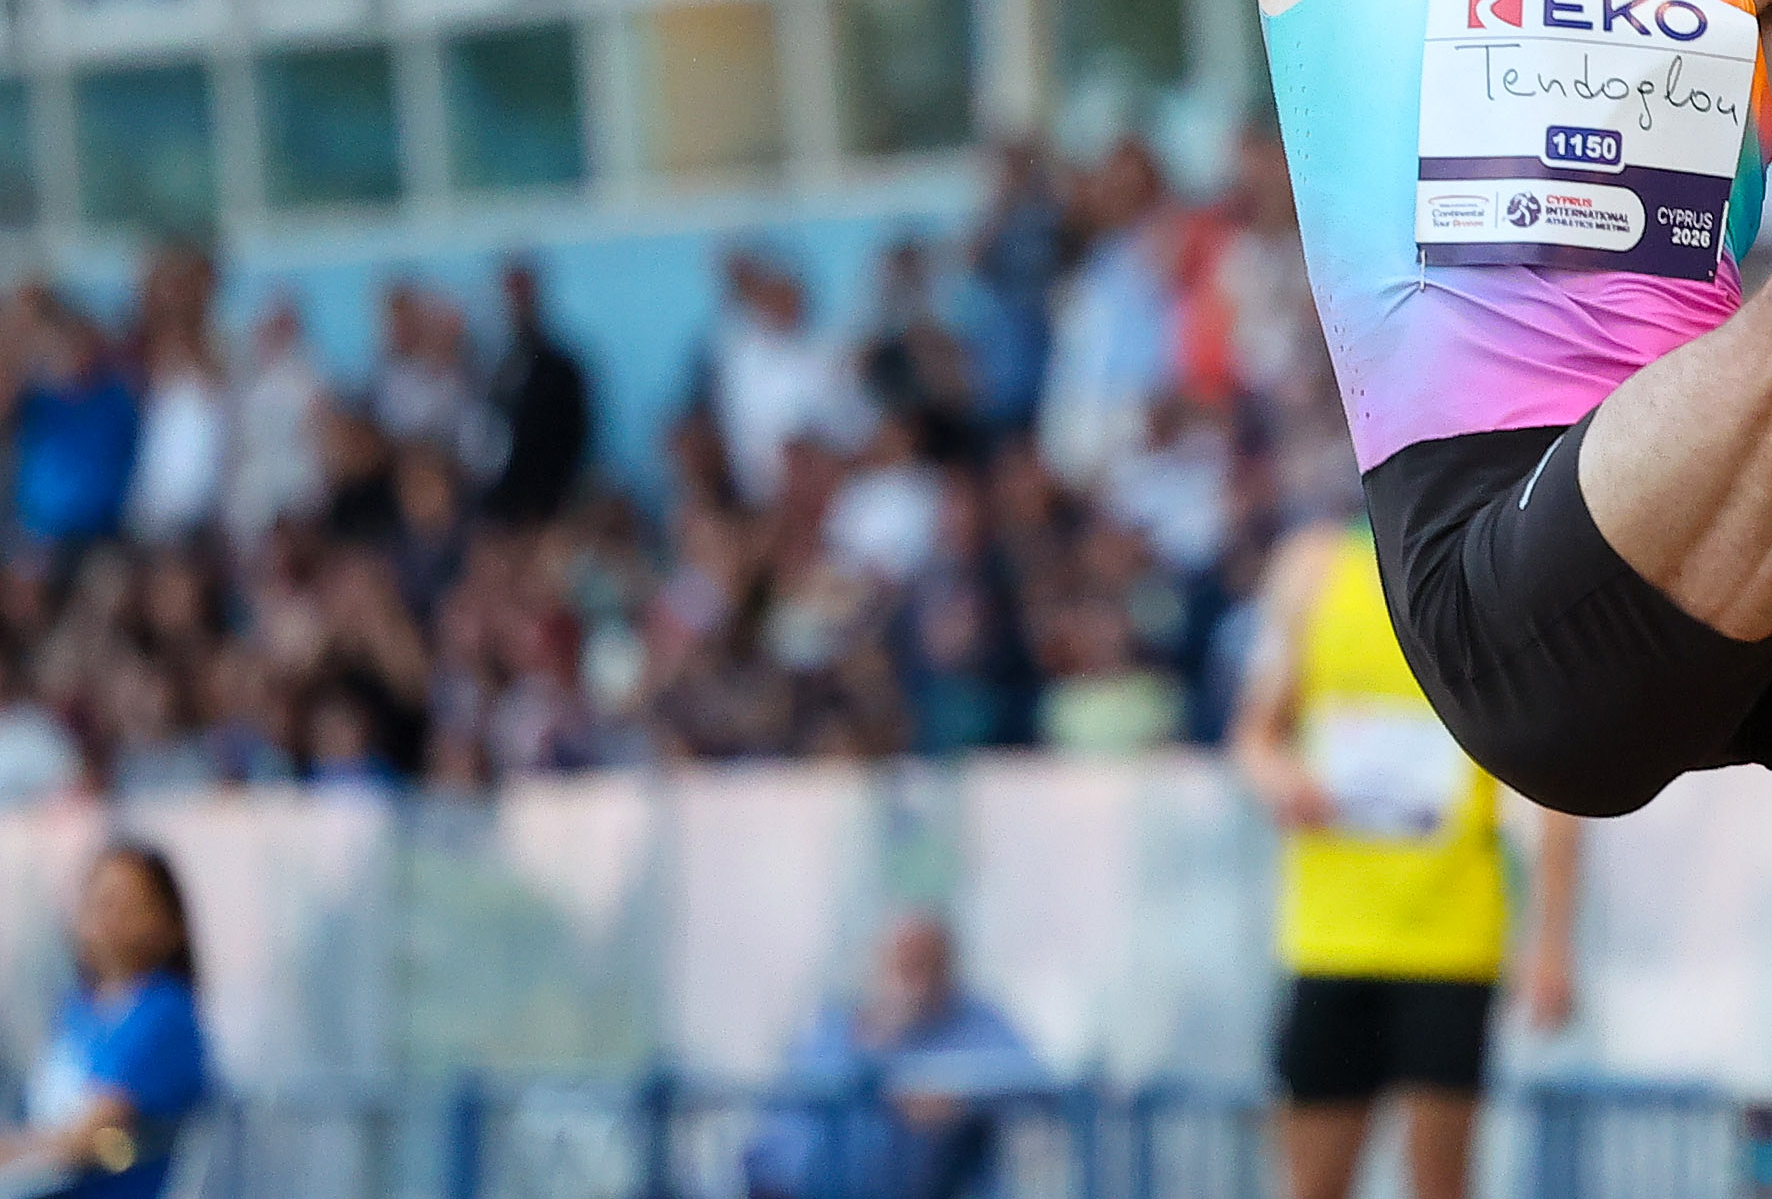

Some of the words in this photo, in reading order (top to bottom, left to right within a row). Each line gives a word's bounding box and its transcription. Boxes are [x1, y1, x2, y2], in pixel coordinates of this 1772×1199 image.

[1455, 43, 1738, 131] Tendoglou
[1552, 131, 1617, 161] 1150
[1546, 194, 1592, 207] CYPRUS
[1545, 206, 1628, 224] INTERNATIONAL
[1545, 217, 1593, 229] ATHLETICS
[1657, 206, 1713, 230] CYPRUS
[1671, 226, 1710, 248] 2026
